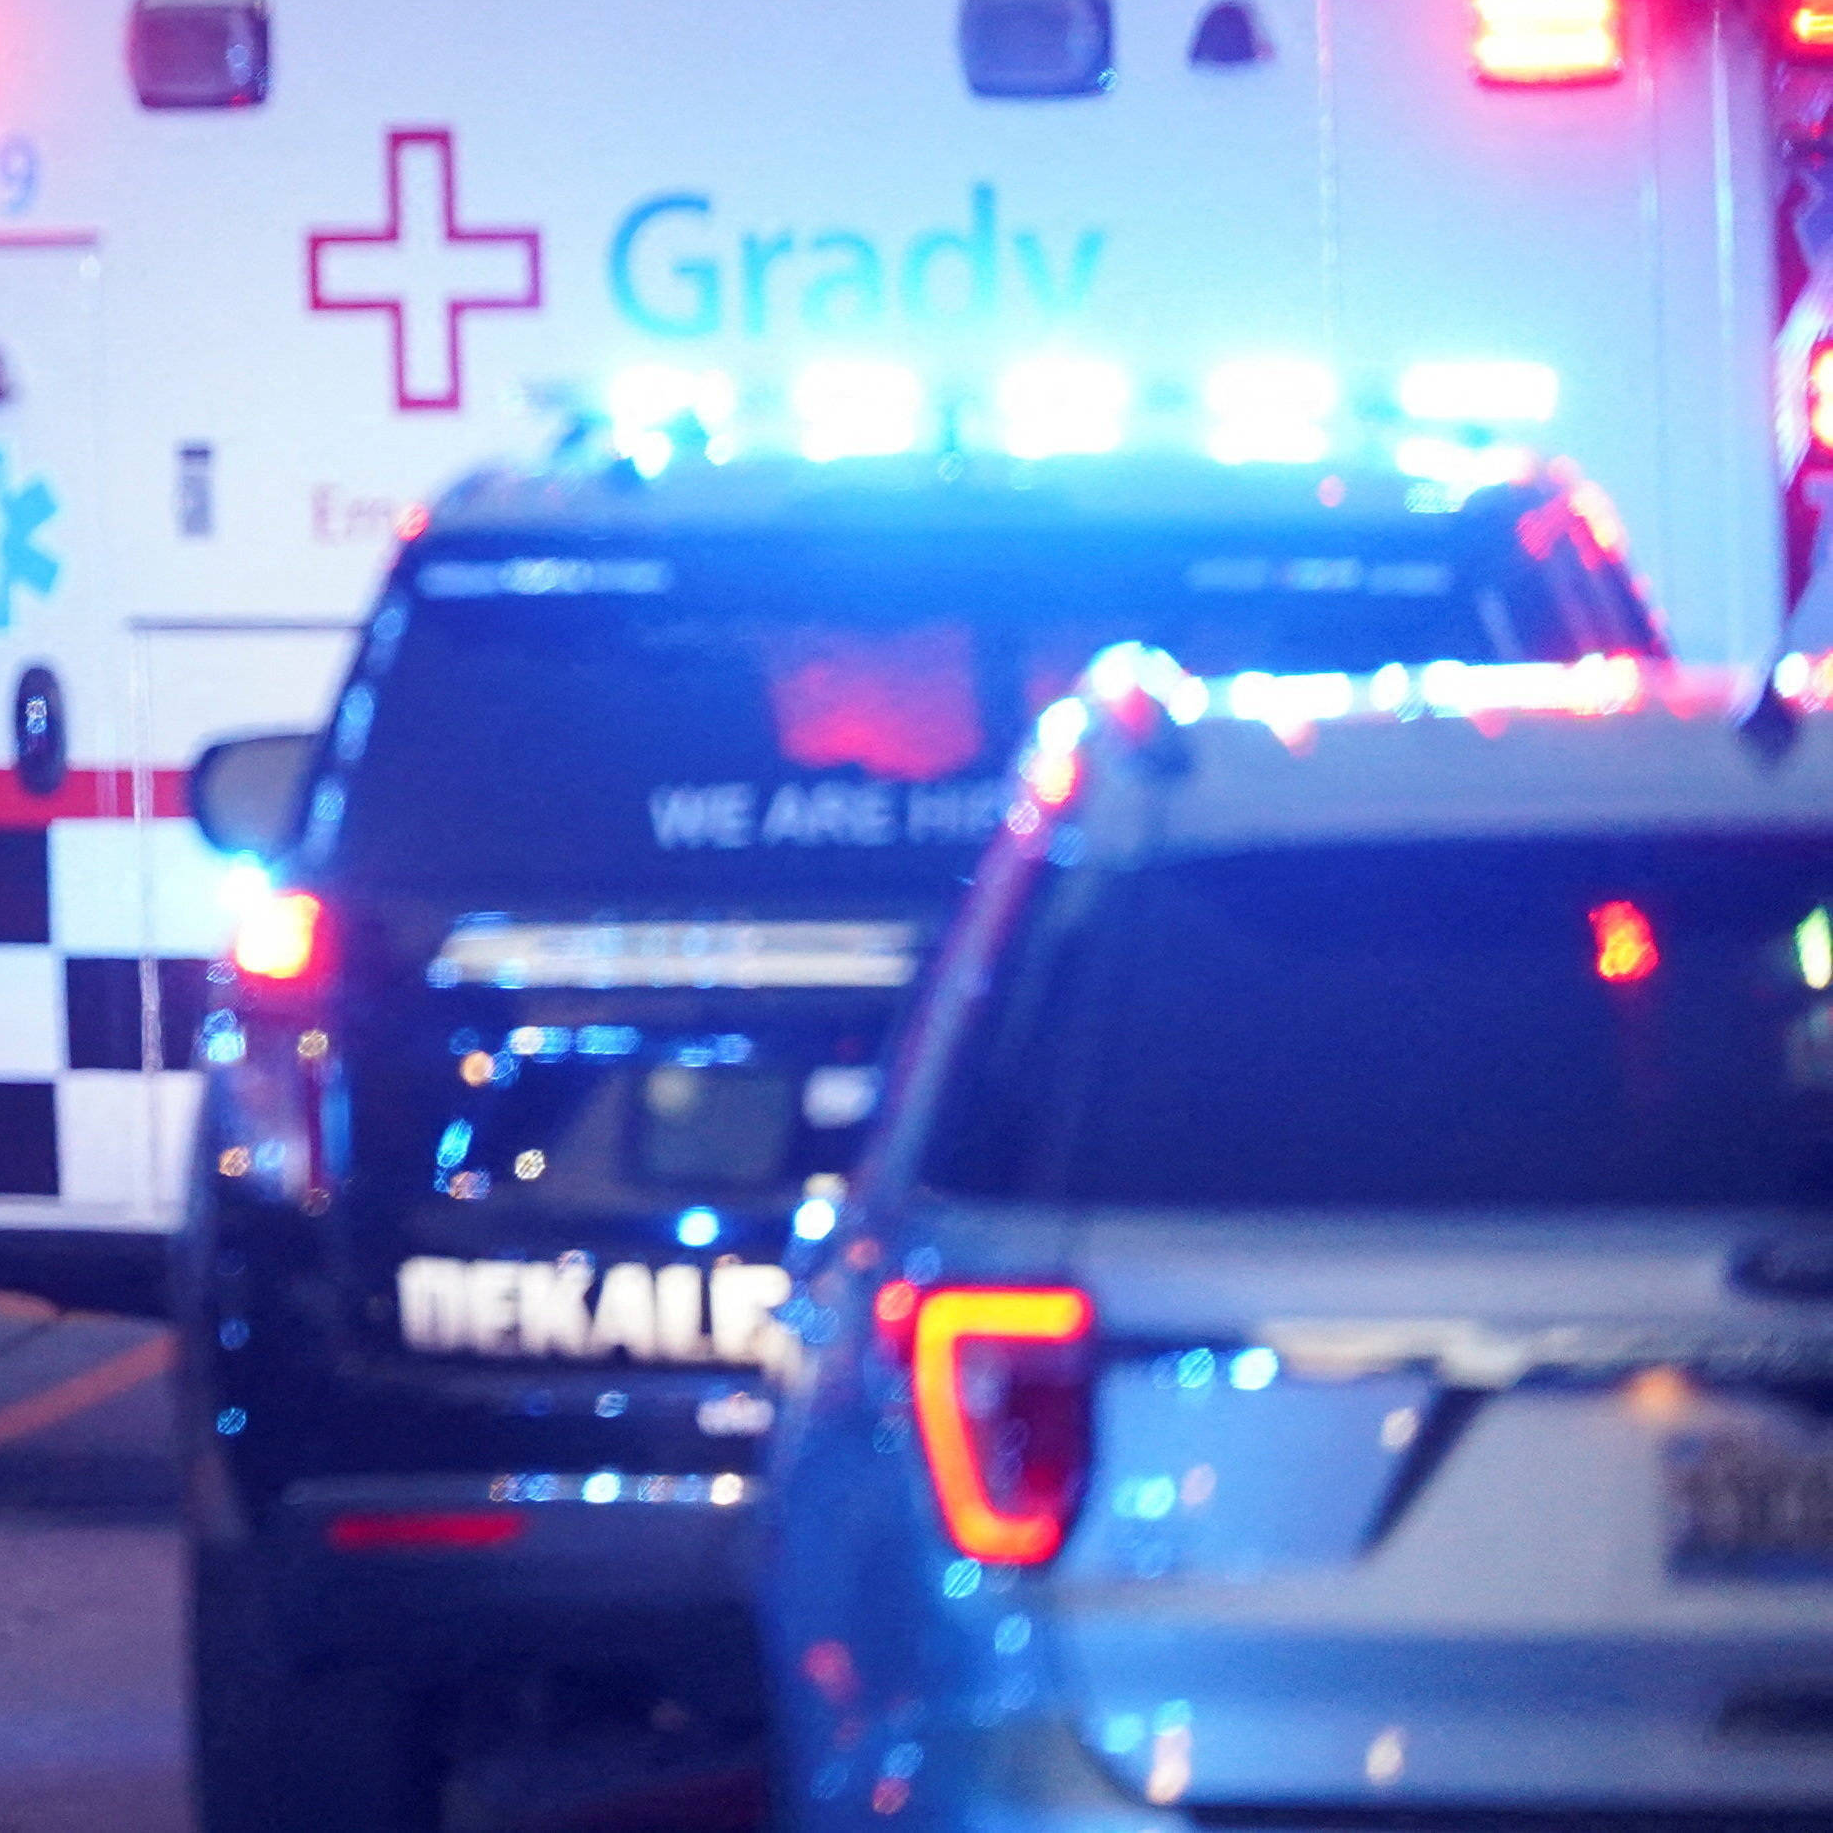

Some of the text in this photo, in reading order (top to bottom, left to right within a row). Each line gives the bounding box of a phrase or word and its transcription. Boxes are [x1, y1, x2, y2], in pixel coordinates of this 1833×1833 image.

[608, 179, 1106, 341] Grady
[646, 779, 757, 850] WE
[761, 779, 898, 848] ARE
